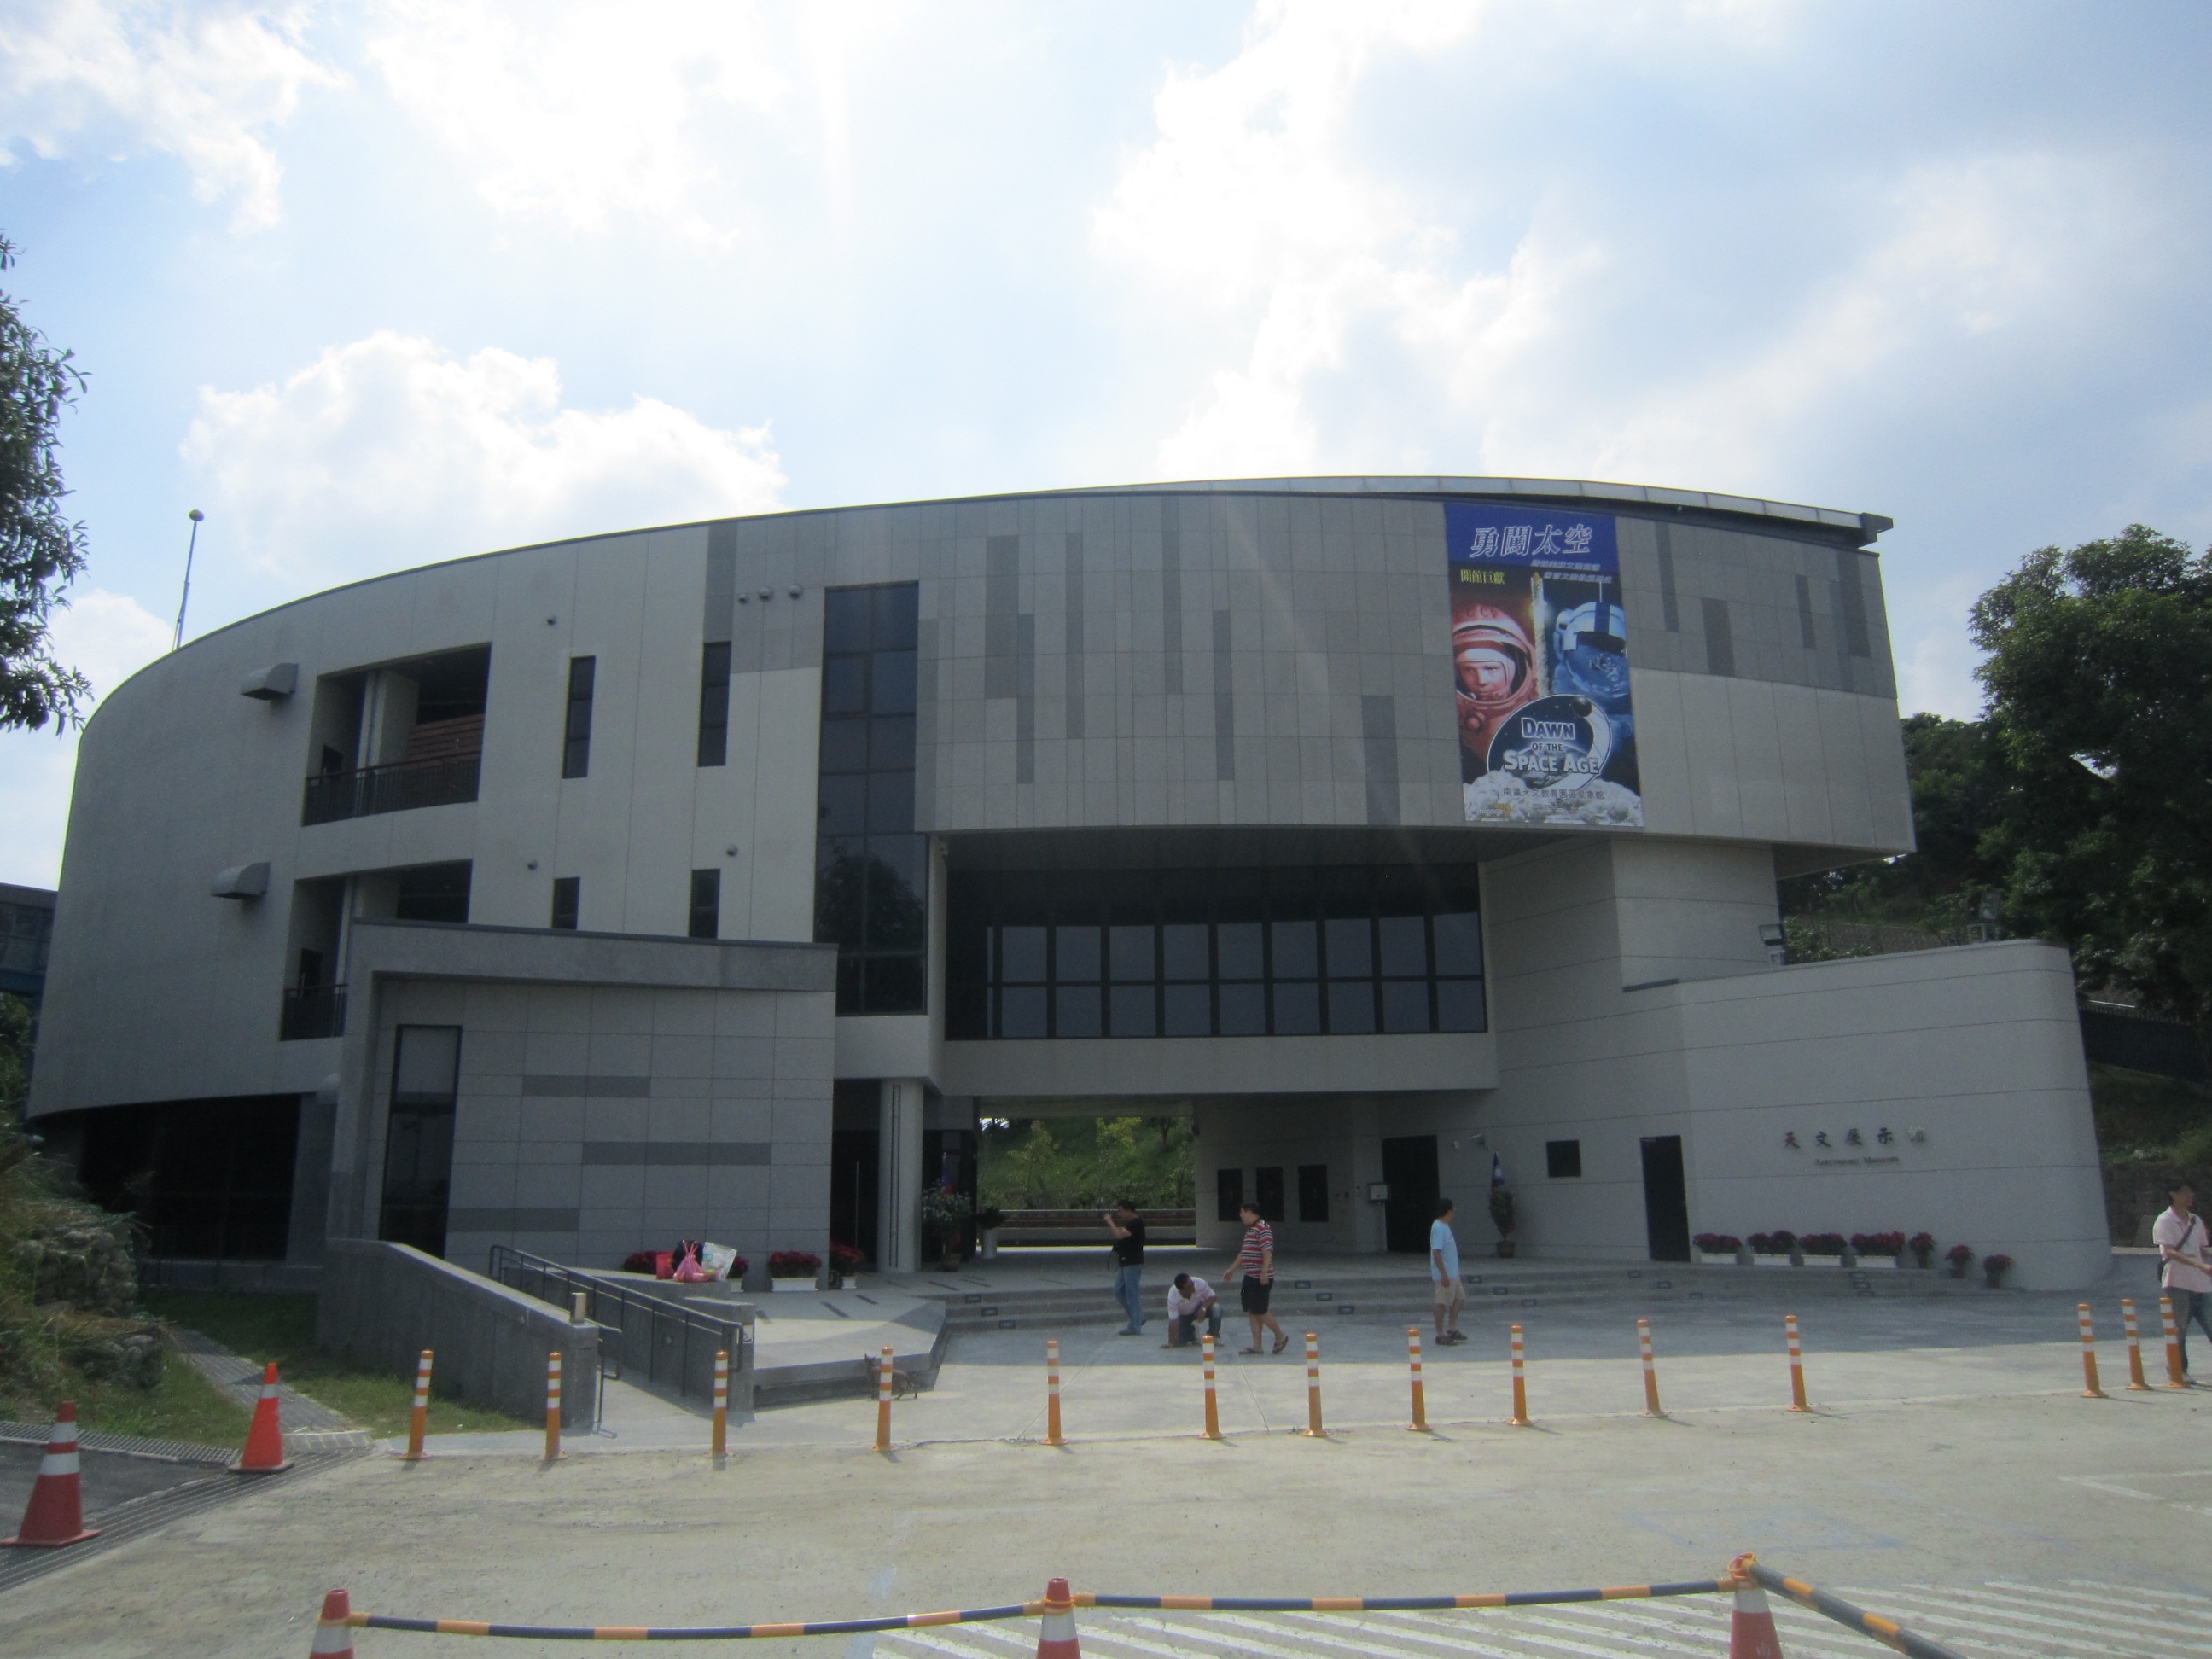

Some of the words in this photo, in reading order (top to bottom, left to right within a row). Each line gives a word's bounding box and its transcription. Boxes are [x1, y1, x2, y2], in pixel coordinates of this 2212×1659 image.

[1469, 523, 1593, 558] 勇闖太空
[1521, 717, 1576, 740] DAWN
[1532, 742, 1543, 751] OF
[1547, 743, 1563, 752] THE
[1503, 749, 1558, 772] SPACE
[1563, 752, 1600, 774] AGE
